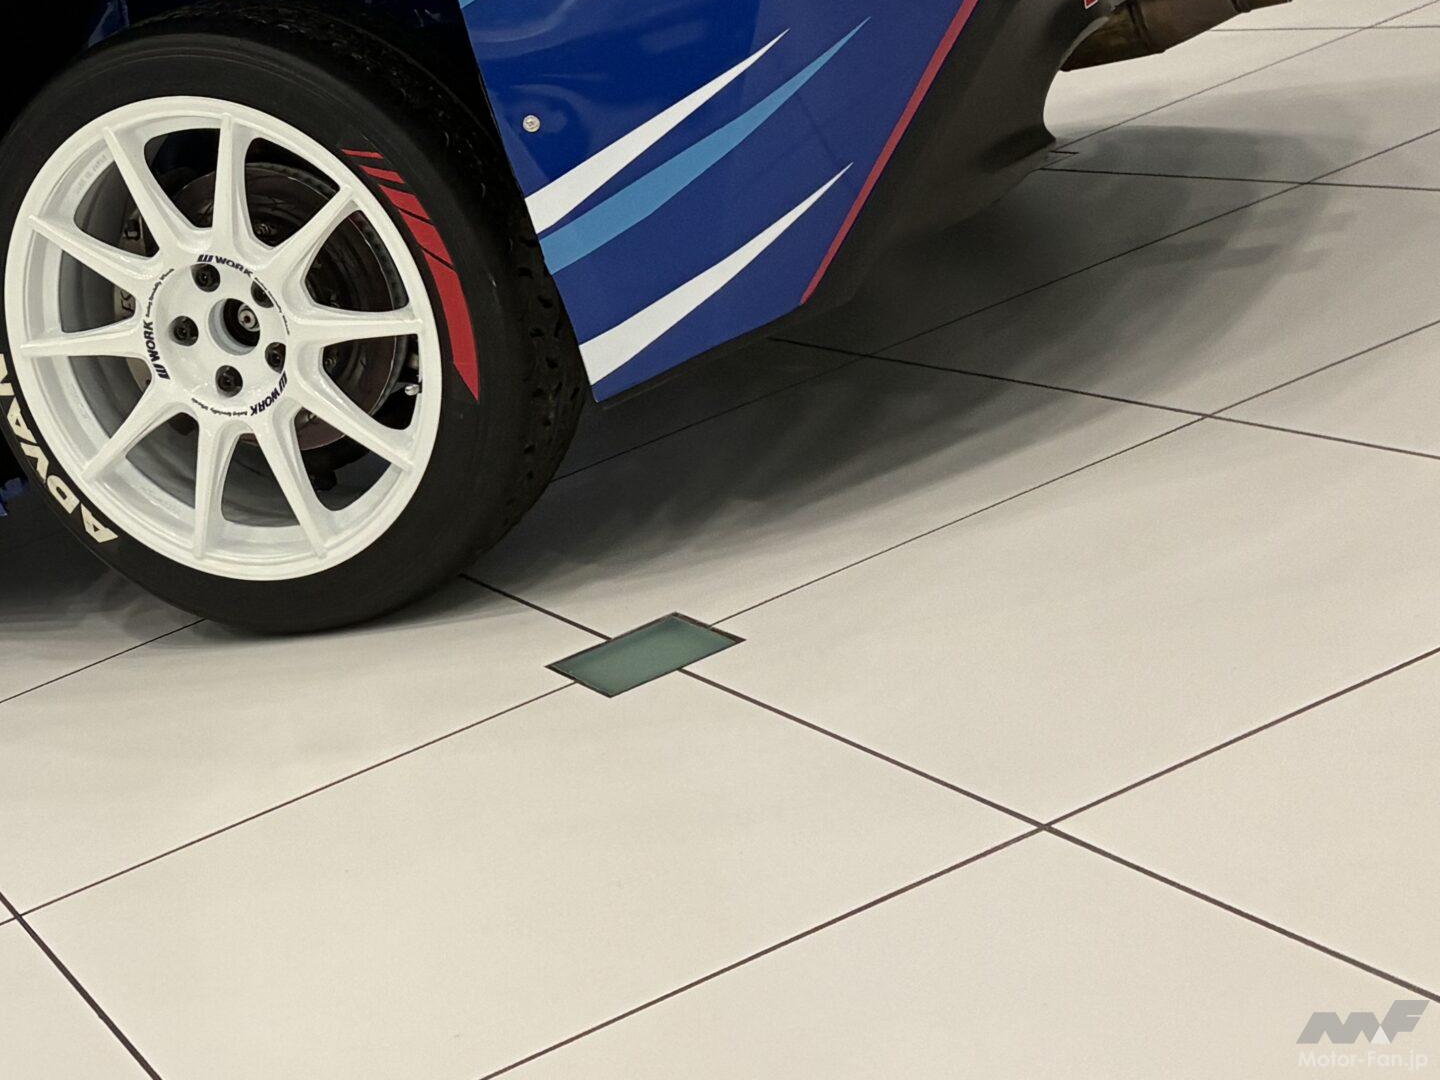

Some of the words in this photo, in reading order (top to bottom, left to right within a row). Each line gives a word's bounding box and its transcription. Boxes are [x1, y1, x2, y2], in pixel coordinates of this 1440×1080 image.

[215, 256, 253, 278] WORK
[143, 320, 160, 362] WORK
[250, 386, 281, 416] WORK
